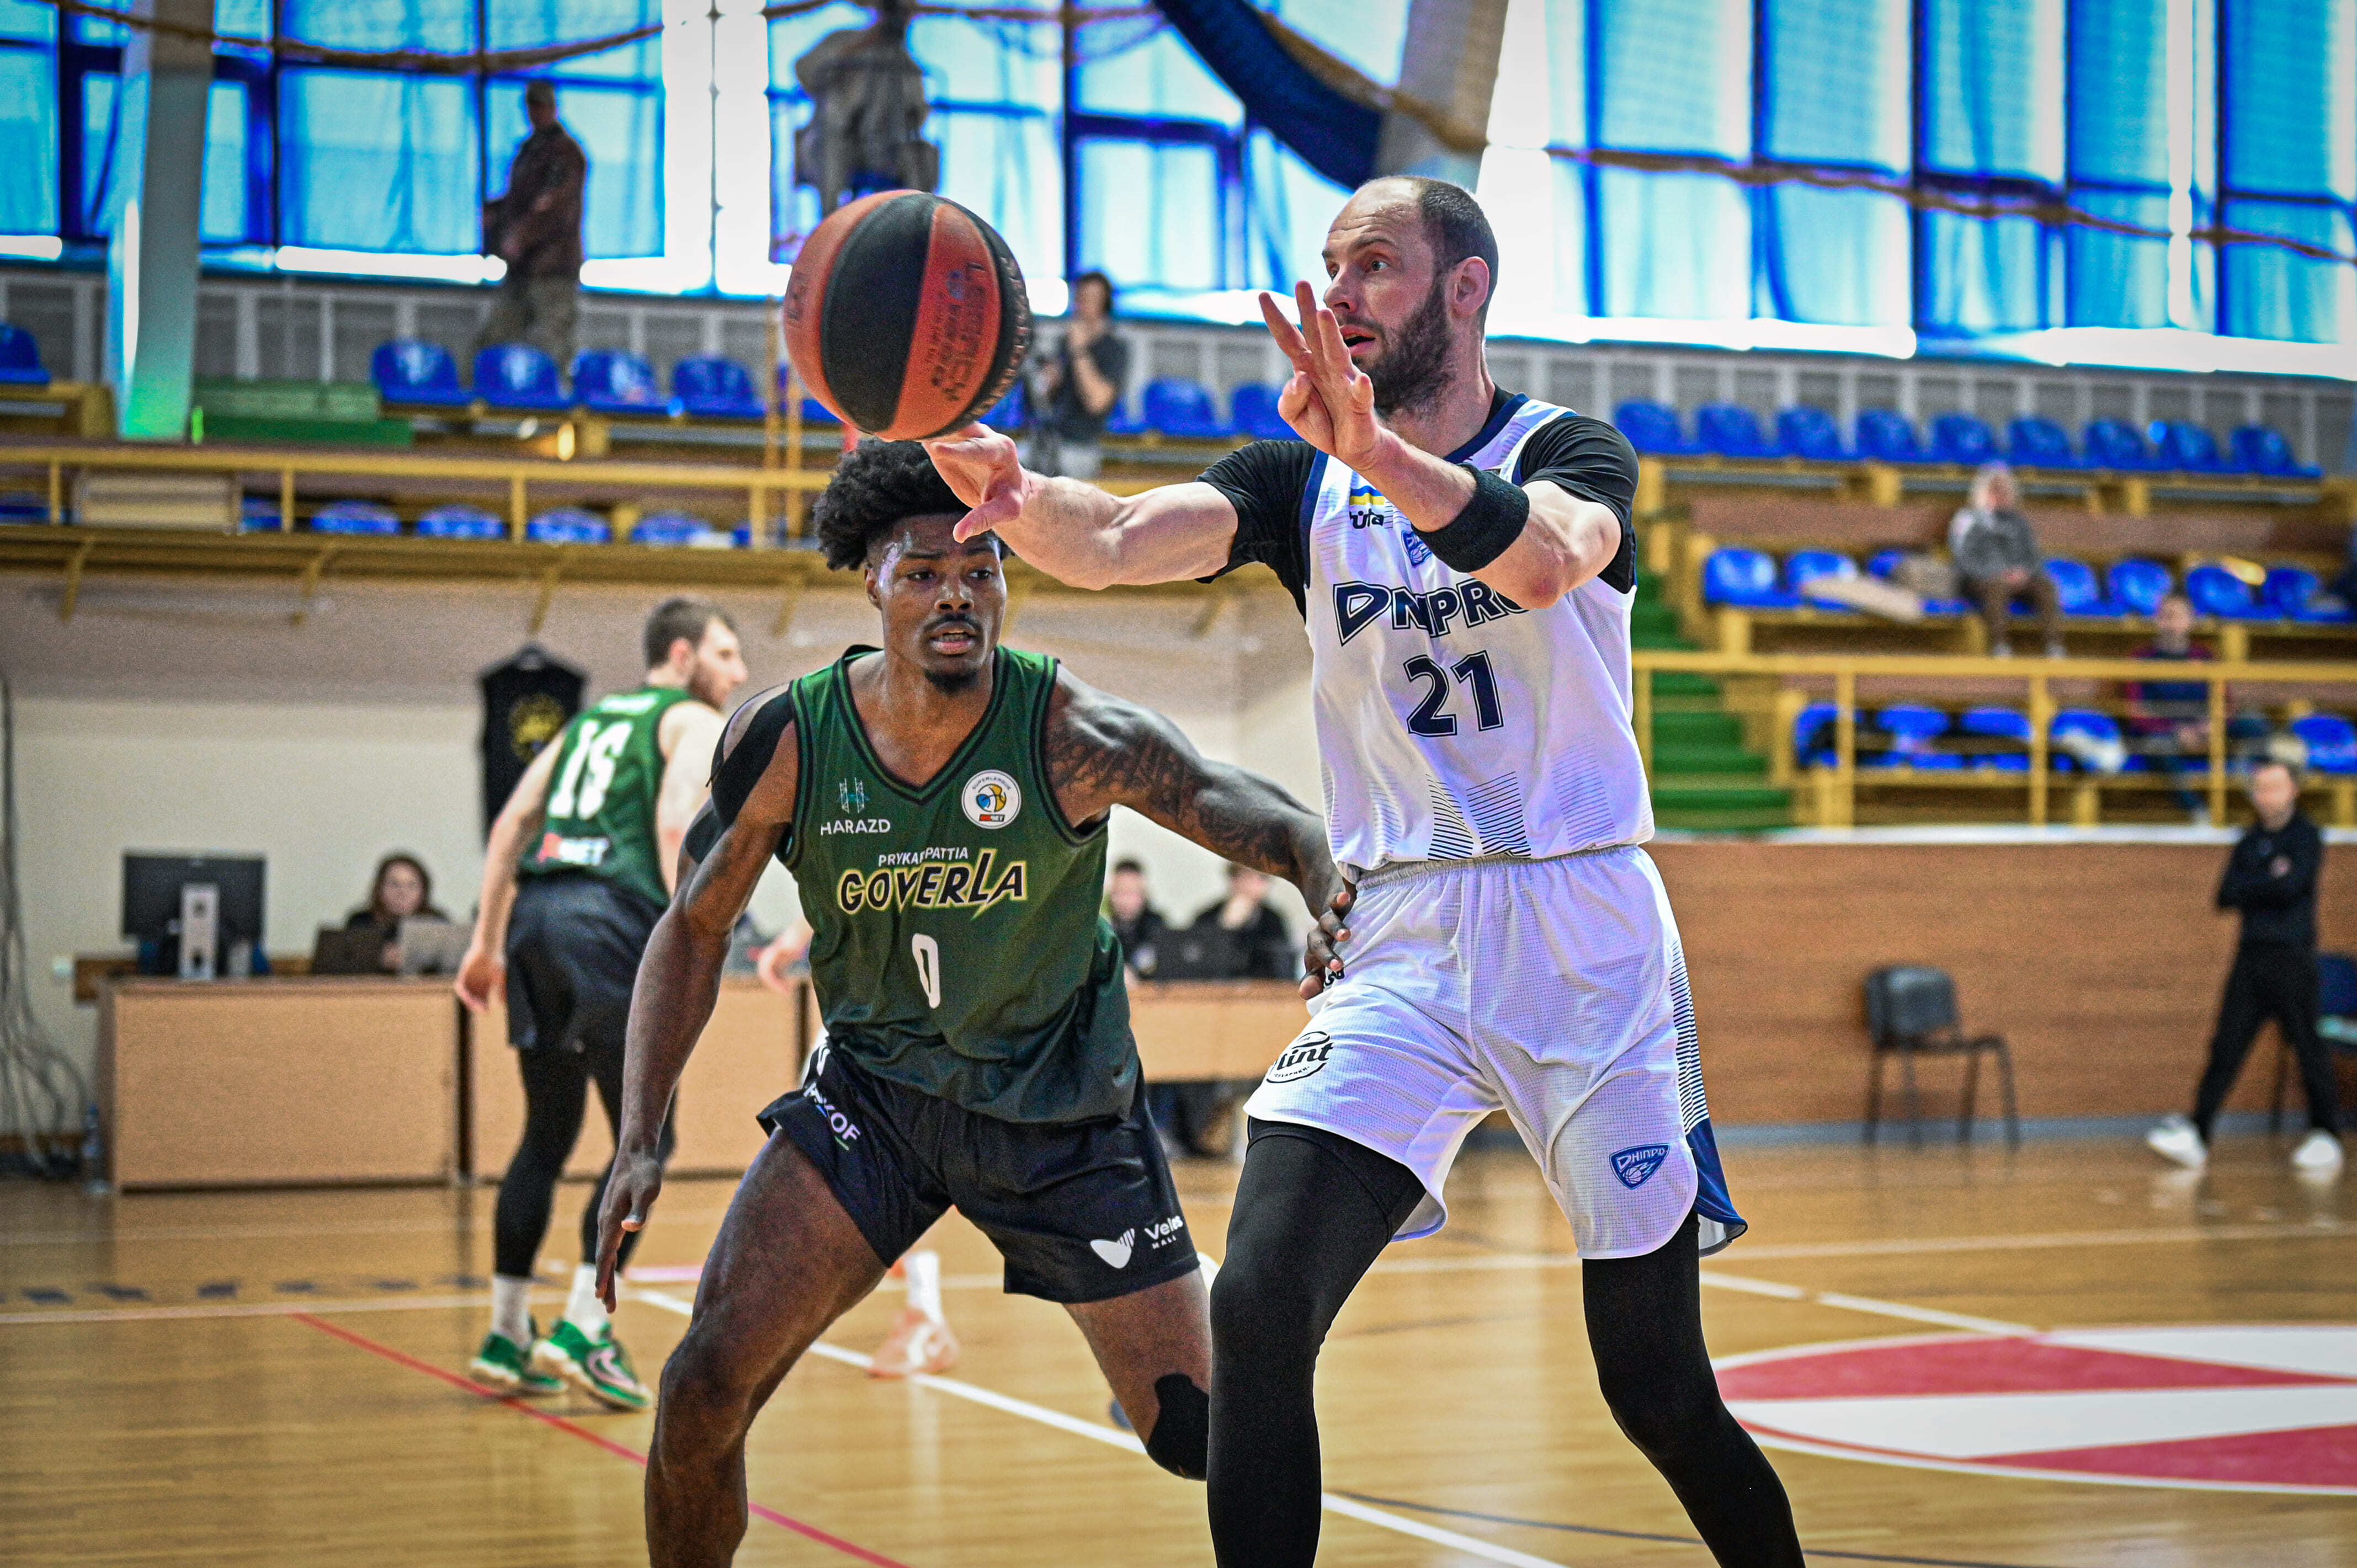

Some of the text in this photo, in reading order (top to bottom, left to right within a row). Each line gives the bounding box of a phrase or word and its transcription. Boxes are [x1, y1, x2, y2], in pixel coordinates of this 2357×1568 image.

[1403, 650, 1504, 738] 21
[821, 819, 891, 835] HARAZD
[837, 848, 1028, 921] GOVERLA
[912, 933, 941, 1009] 0
